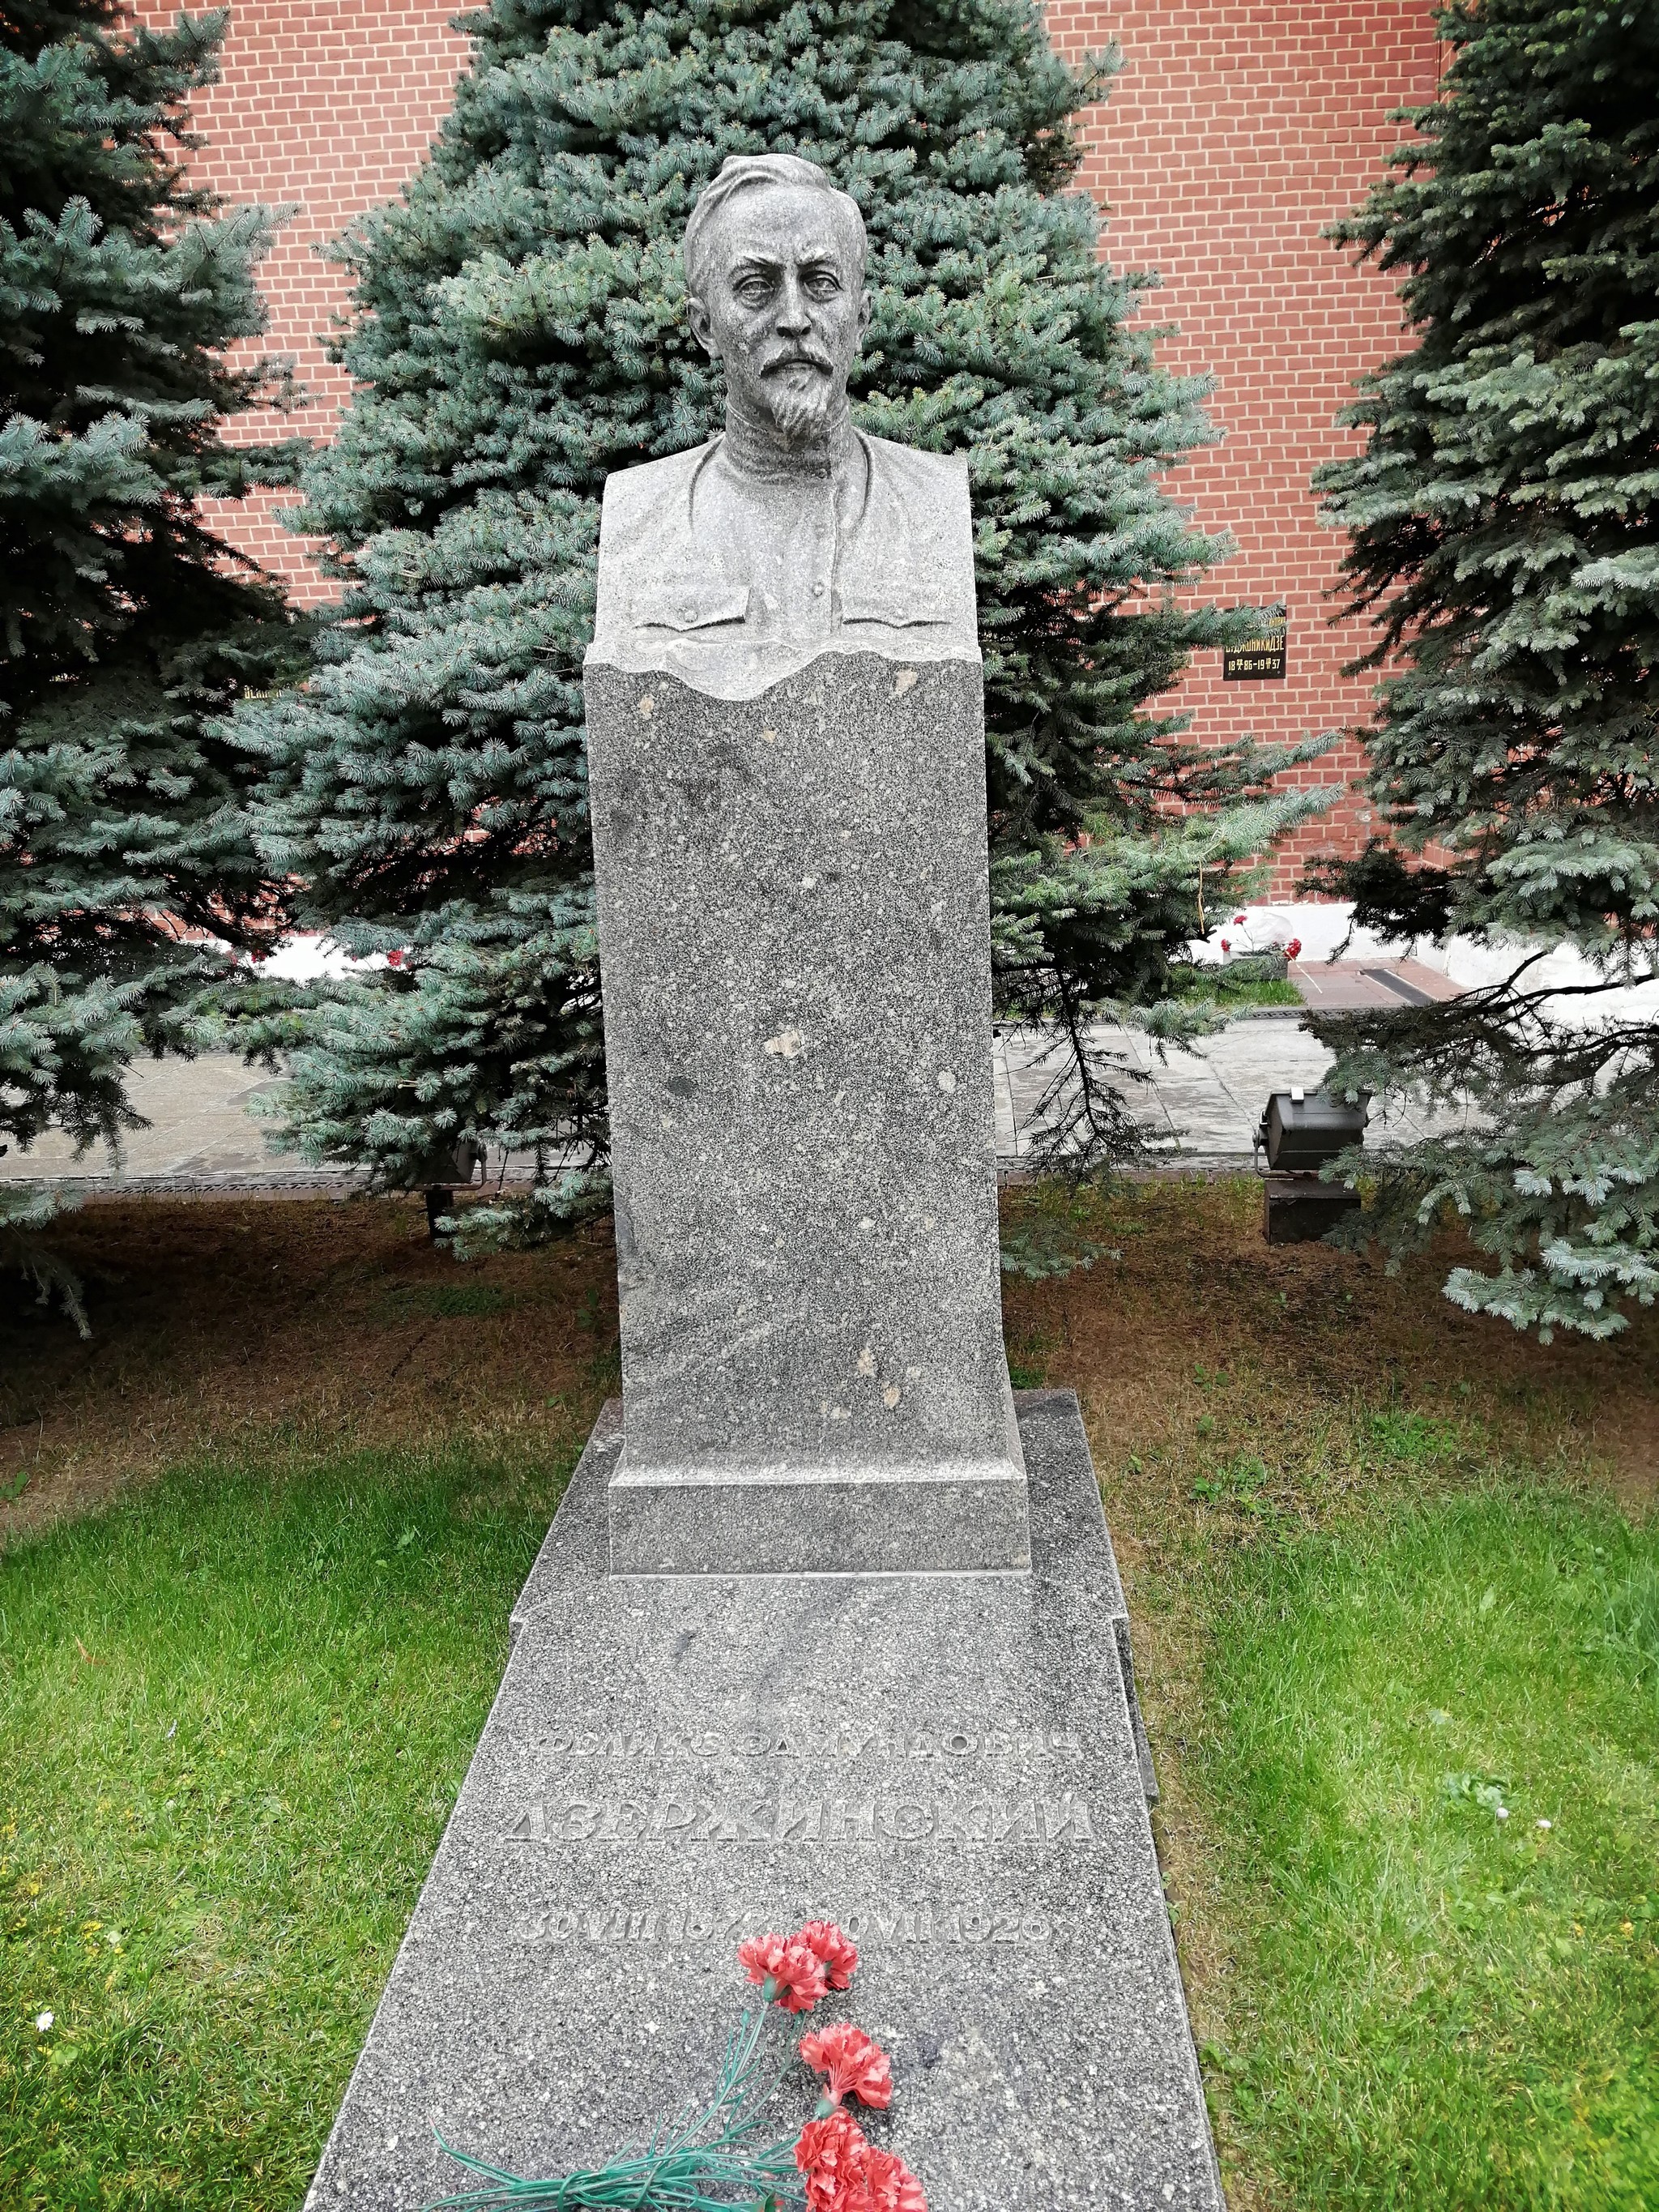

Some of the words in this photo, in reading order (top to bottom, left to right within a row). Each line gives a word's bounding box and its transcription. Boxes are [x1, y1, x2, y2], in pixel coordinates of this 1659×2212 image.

[531, 1732, 726, 1757] ФЕЛИКС
[734, 1732, 1084, 1757] ЭДМУНДОВИЧ
[504, 1793, 1096, 1844] ДЗЕРЖИНСКИЙ
